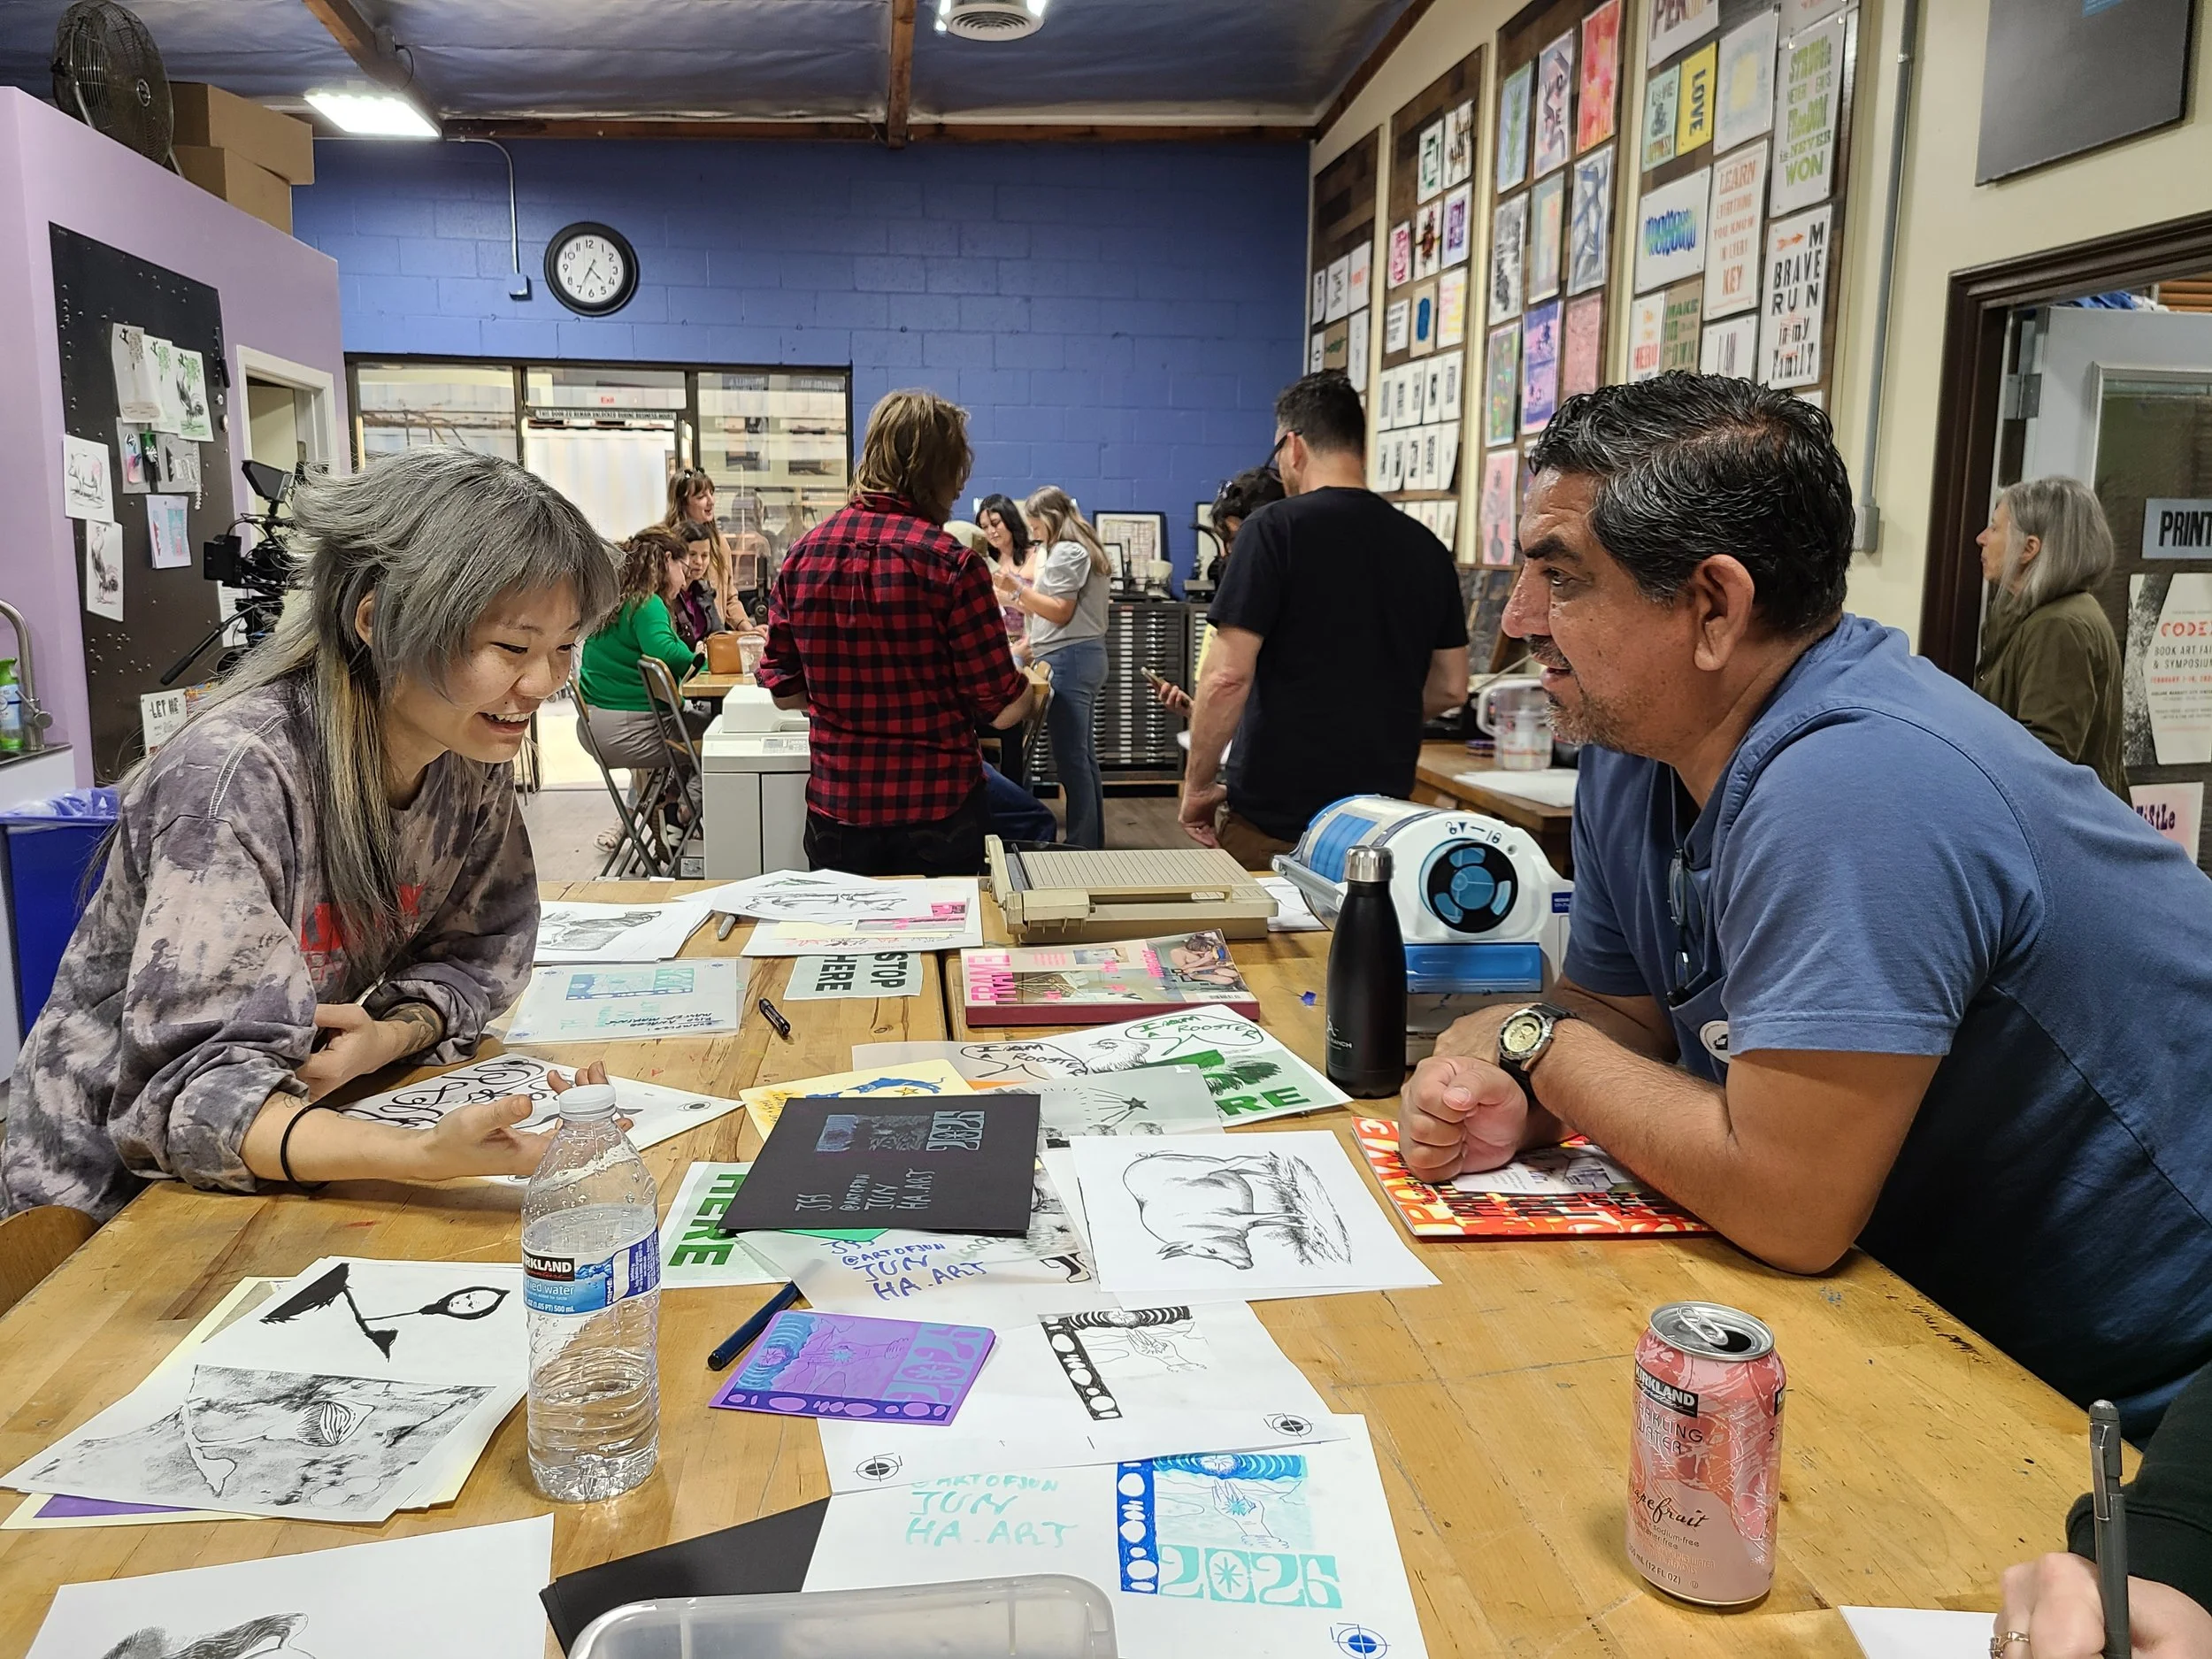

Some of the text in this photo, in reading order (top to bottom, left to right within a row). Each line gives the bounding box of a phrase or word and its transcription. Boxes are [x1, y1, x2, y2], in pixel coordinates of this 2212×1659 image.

[1689, 69, 1706, 136] LOVE
[1791, 129, 1831, 157] NEVER
[1719, 165, 1756, 195] LEARN
[1786, 150, 1824, 188] WON
[564, 251, 576, 260] 10
[575, 242, 581, 252] 11
[585, 239, 595, 249] 12
[1722, 265, 1743, 296] KEY
[1773, 249, 1822, 290] BRAVE
[1771, 283, 1818, 316] RUN
[2161, 621, 2212, 637] CODE
[2154, 644, 2212, 656] BOOK ART FAI
[2164, 658, 2212, 669] SYMPOSIU
[816, 955, 857, 992] HERE
[871, 952, 910, 989] STOP
[967, 955, 1016, 1002] FRAME
[864, 1183, 898, 1210] JUN
[896, 1168, 935, 1210] HA.ART
[524, 1254, 572, 1273] RKLAND
[841, 1242, 947, 1266] @ARTOFJUN
[852, 1255, 929, 1283] JUN
[873, 1261, 987, 1302] HA.ART
[544, 1285, 575, 1295] water
[554, 1304, 565, 1313] 500
[1635, 1364, 1695, 1407] KIRKLAND
[1637, 1399, 1703, 1442] ARKLING
[910, 1490, 1018, 1516] JUN
[1632, 1484, 1710, 1528] apefruit
[906, 1517, 1079, 1548] HA.ART
[1653, 1524, 1700, 1548] sodium-free
[1158, 1543, 1343, 1609] 2026
[1645, 1559, 1656, 1572] (12
[1656, 1567, 1664, 1578] FL
[1667, 1571, 1681, 1586] OZ)
